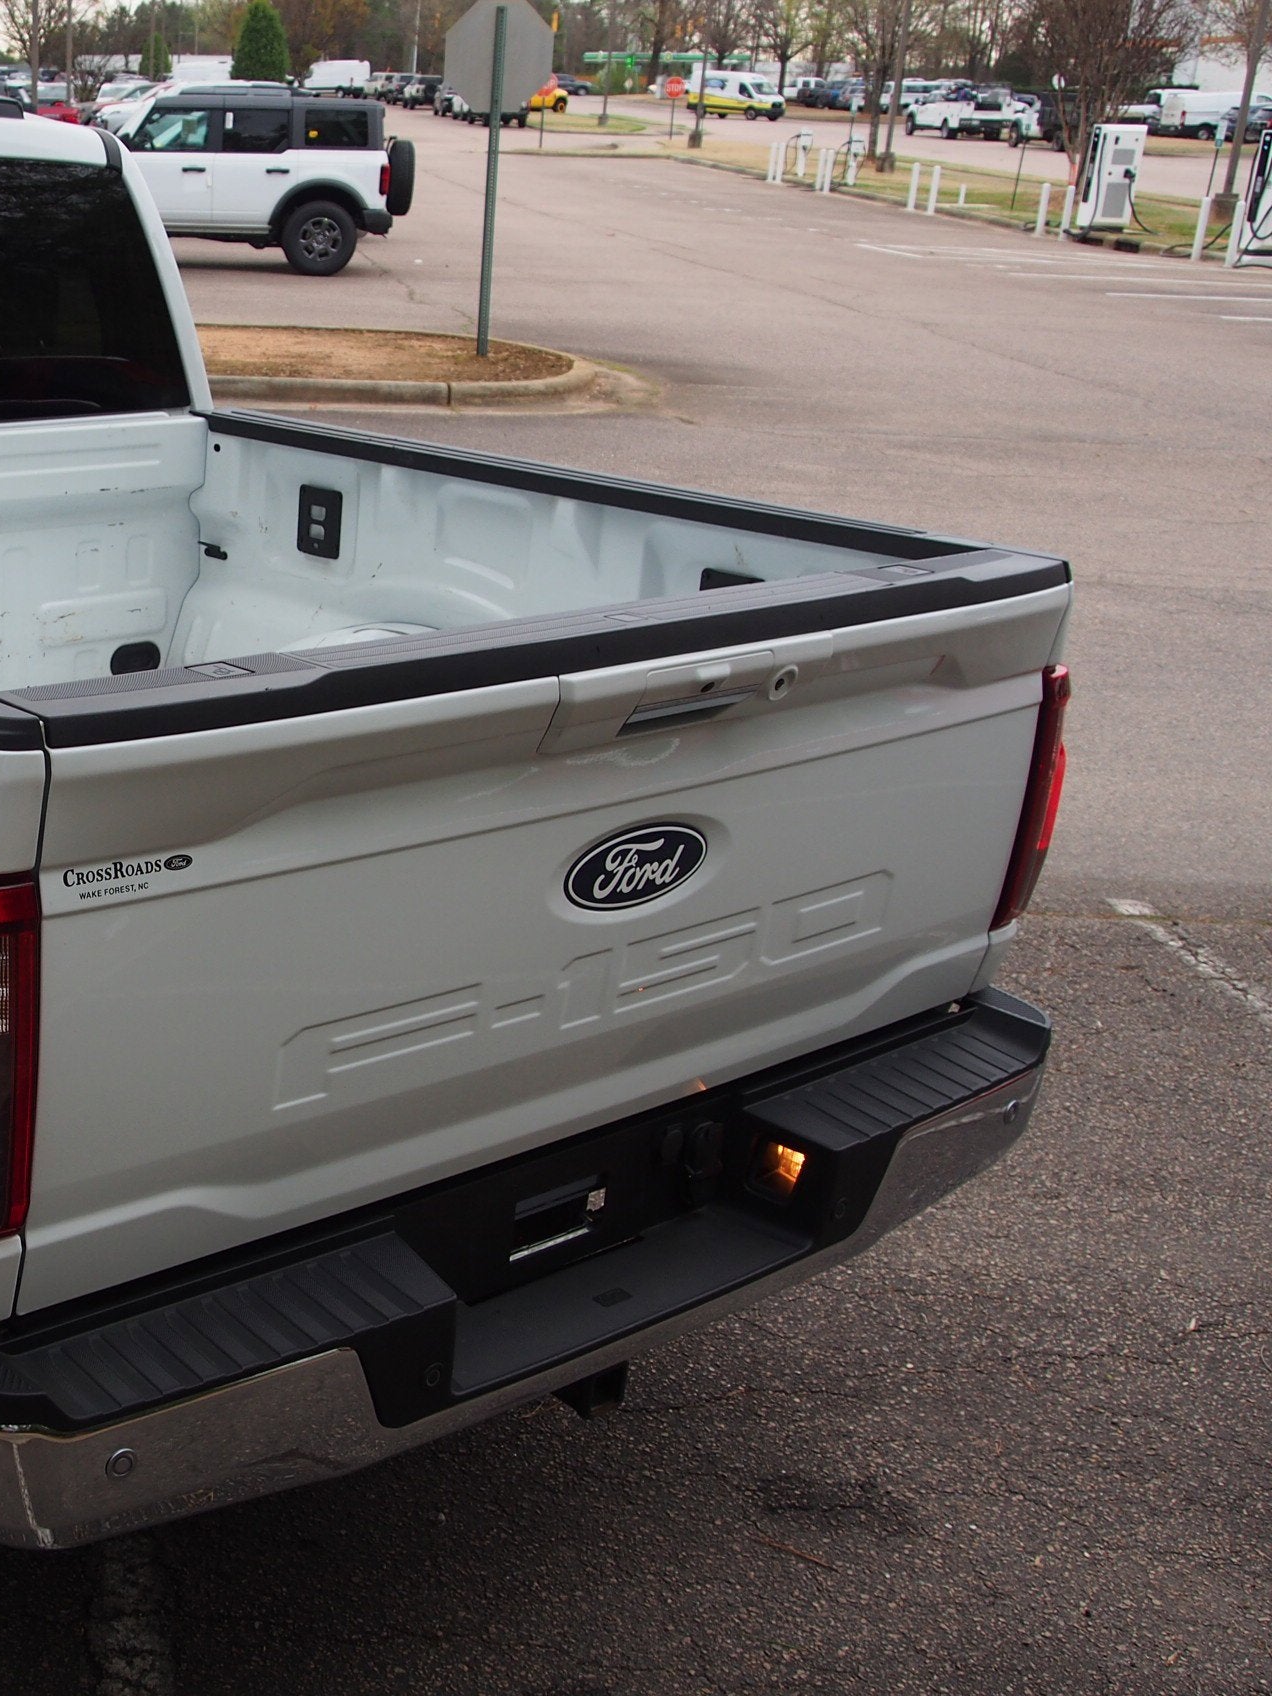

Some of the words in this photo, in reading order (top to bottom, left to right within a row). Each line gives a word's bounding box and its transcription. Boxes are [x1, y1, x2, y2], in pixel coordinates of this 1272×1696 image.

[666, 83, 685, 92] STOP
[78, 888, 103, 900] WAKE
[104, 884, 137, 897] FOREST,
[137, 881, 149, 891] NC
[272, 869, 895, 1110] F-150
